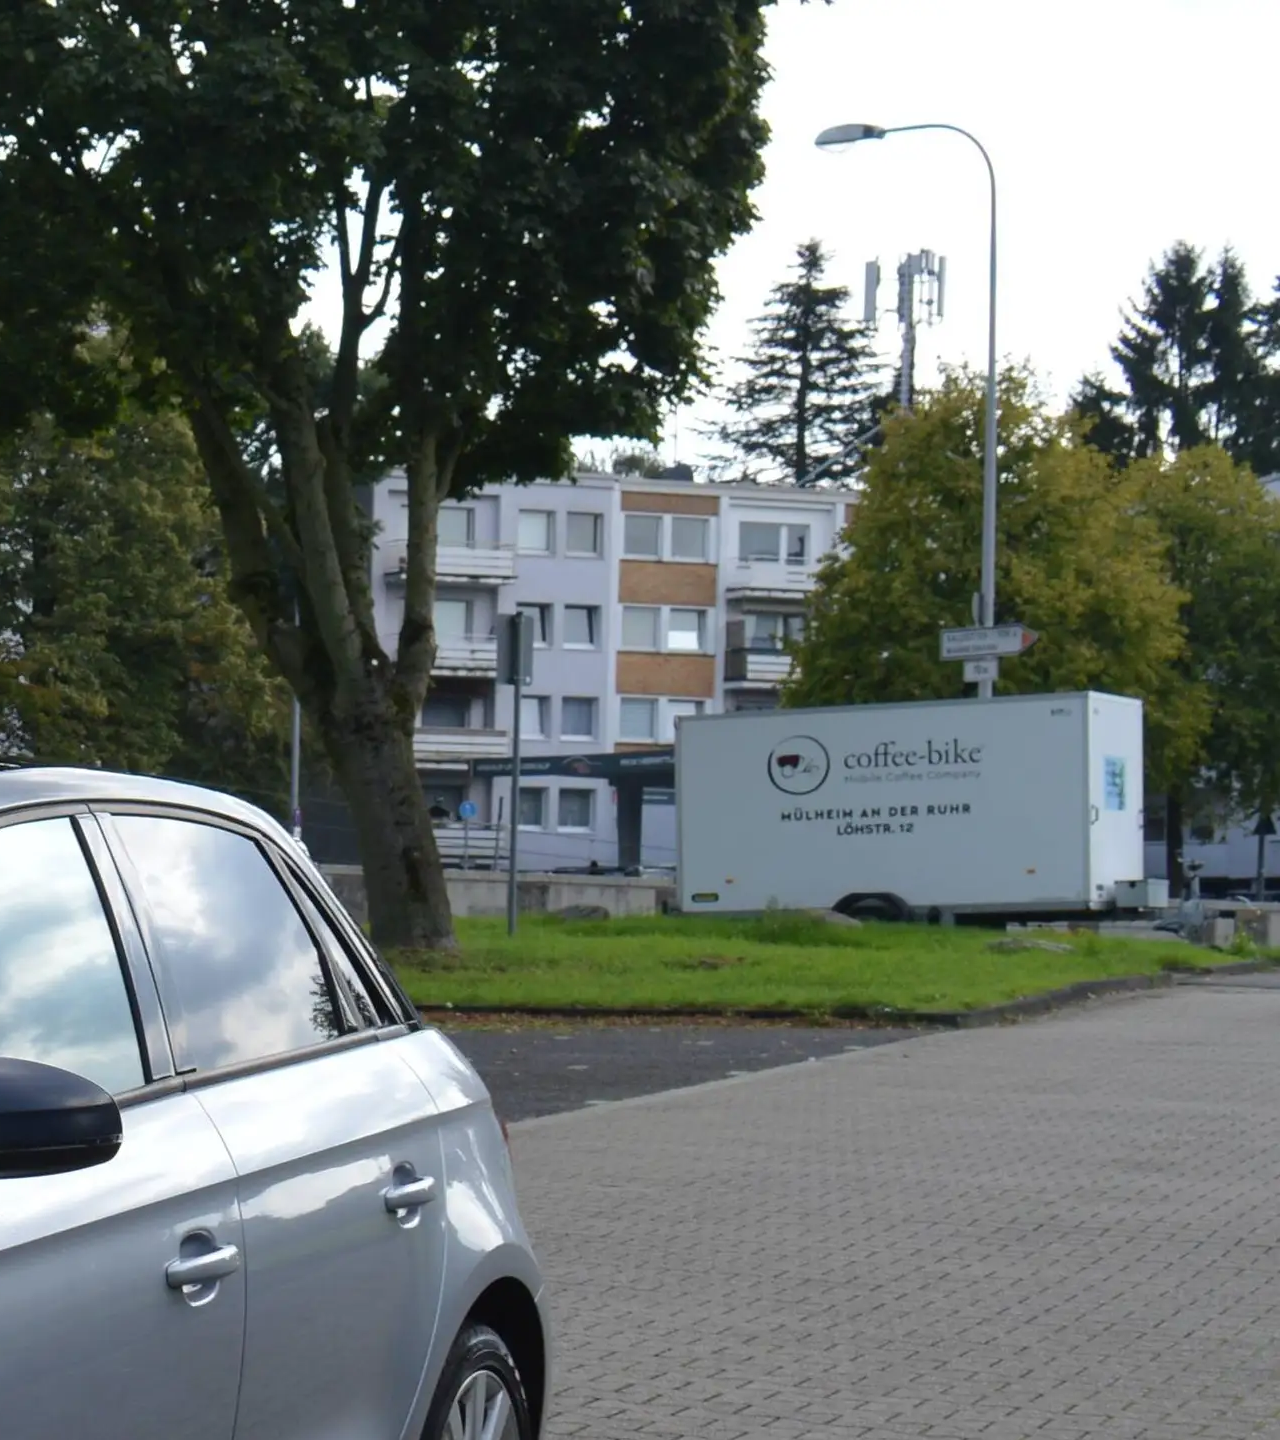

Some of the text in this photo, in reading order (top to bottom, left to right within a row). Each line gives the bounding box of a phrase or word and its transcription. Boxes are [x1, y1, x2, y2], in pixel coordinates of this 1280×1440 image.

[843, 738, 982, 770] coffee-bike
[781, 803, 971, 822] MÜLHEIM AN DER RUHR
[836, 821, 914, 836] LÖHSTR. 12
